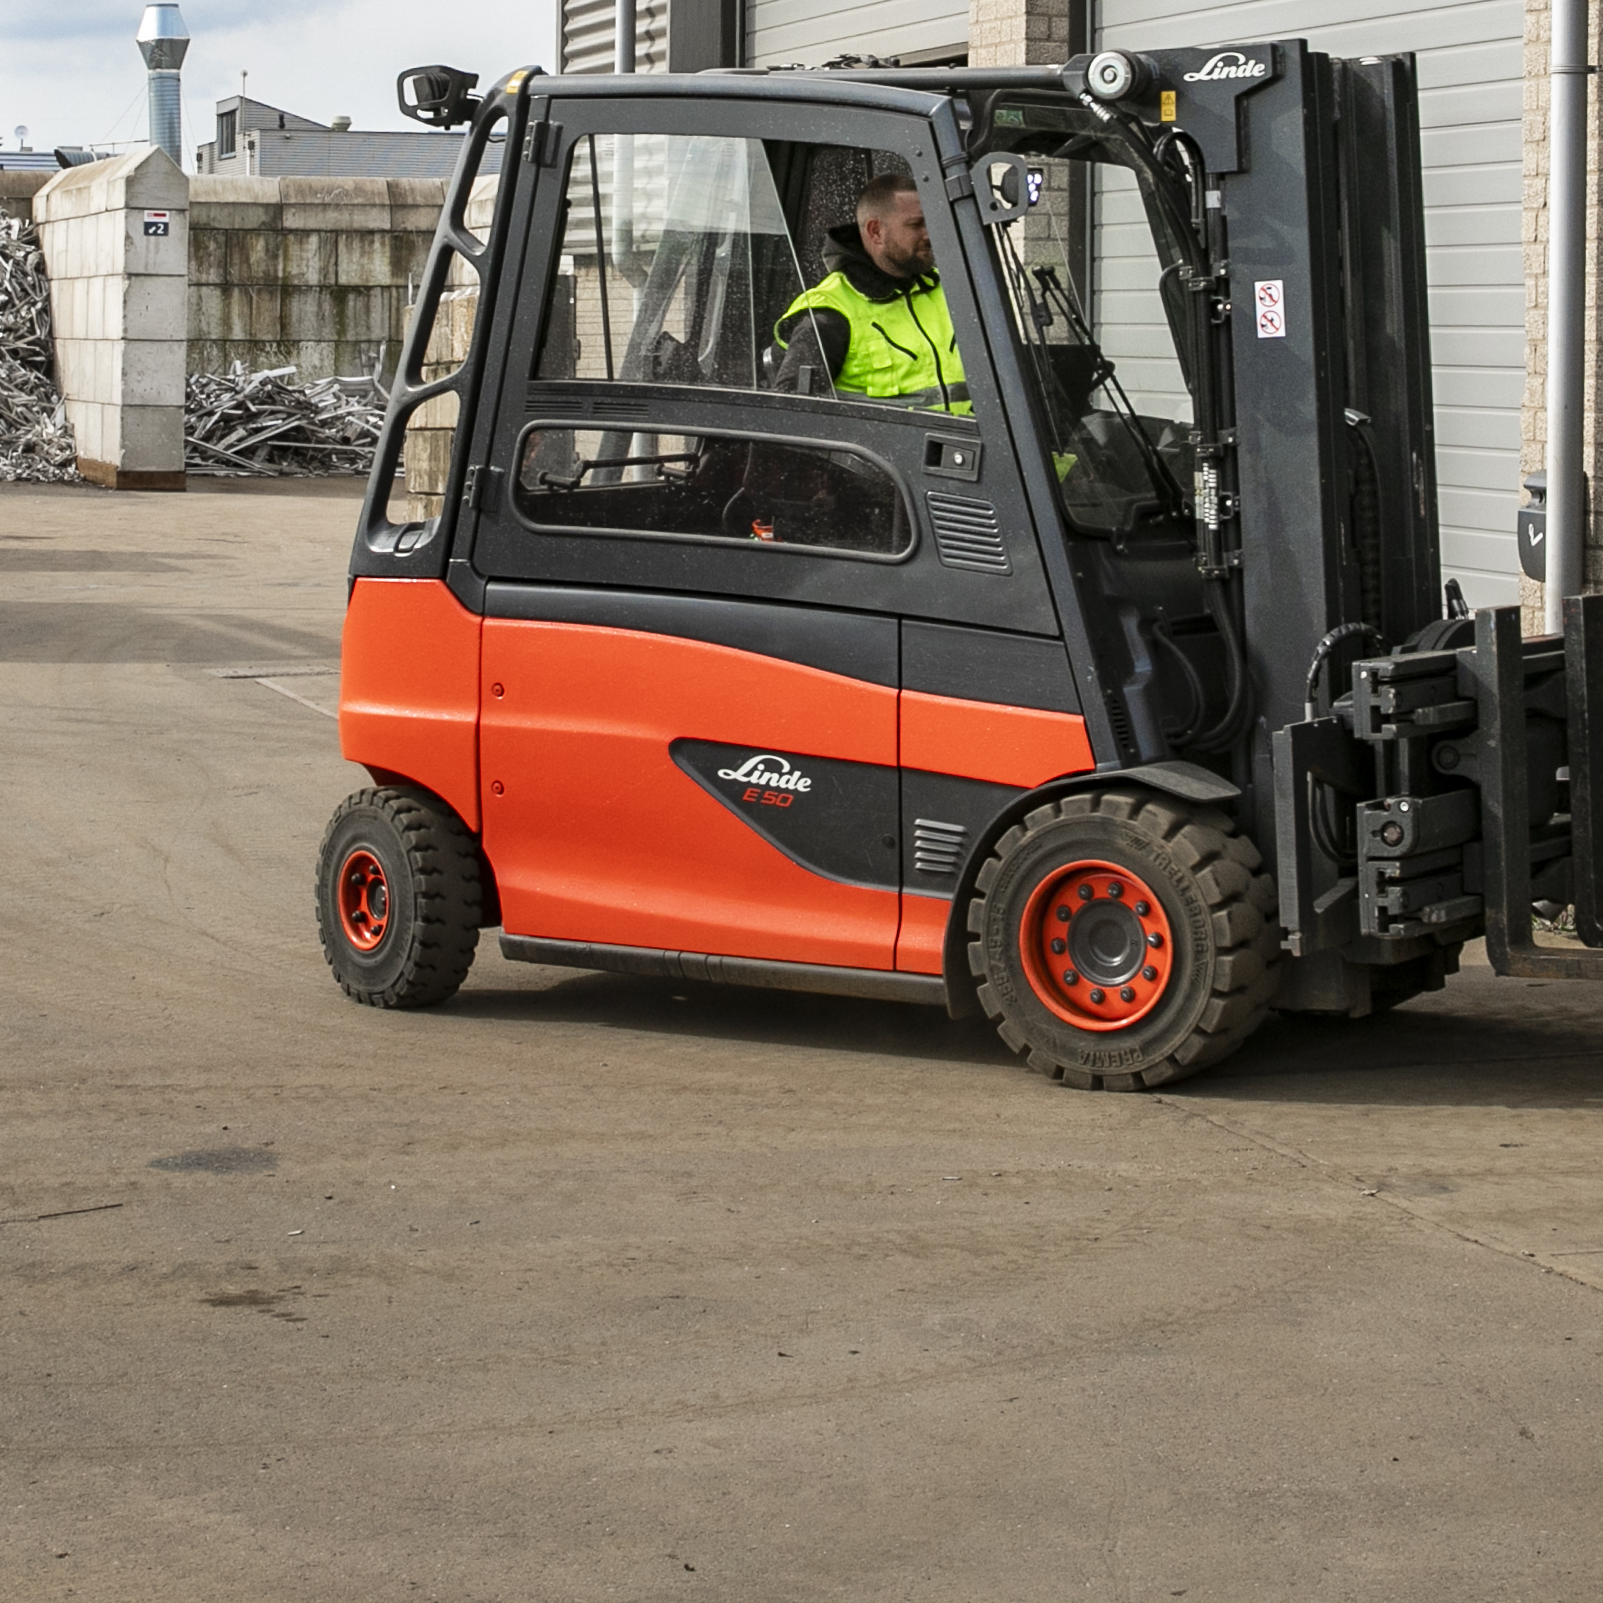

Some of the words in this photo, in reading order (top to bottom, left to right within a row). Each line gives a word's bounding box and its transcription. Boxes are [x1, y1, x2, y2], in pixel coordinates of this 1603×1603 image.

[1183, 52, 1265, 82] Linde
[157, 223, 165, 234] 2
[717, 754, 812, 792] Linde
[742, 787, 761, 802] E
[760, 790, 794, 808] 50
[1078, 1047, 1144, 1067] PREMIA
